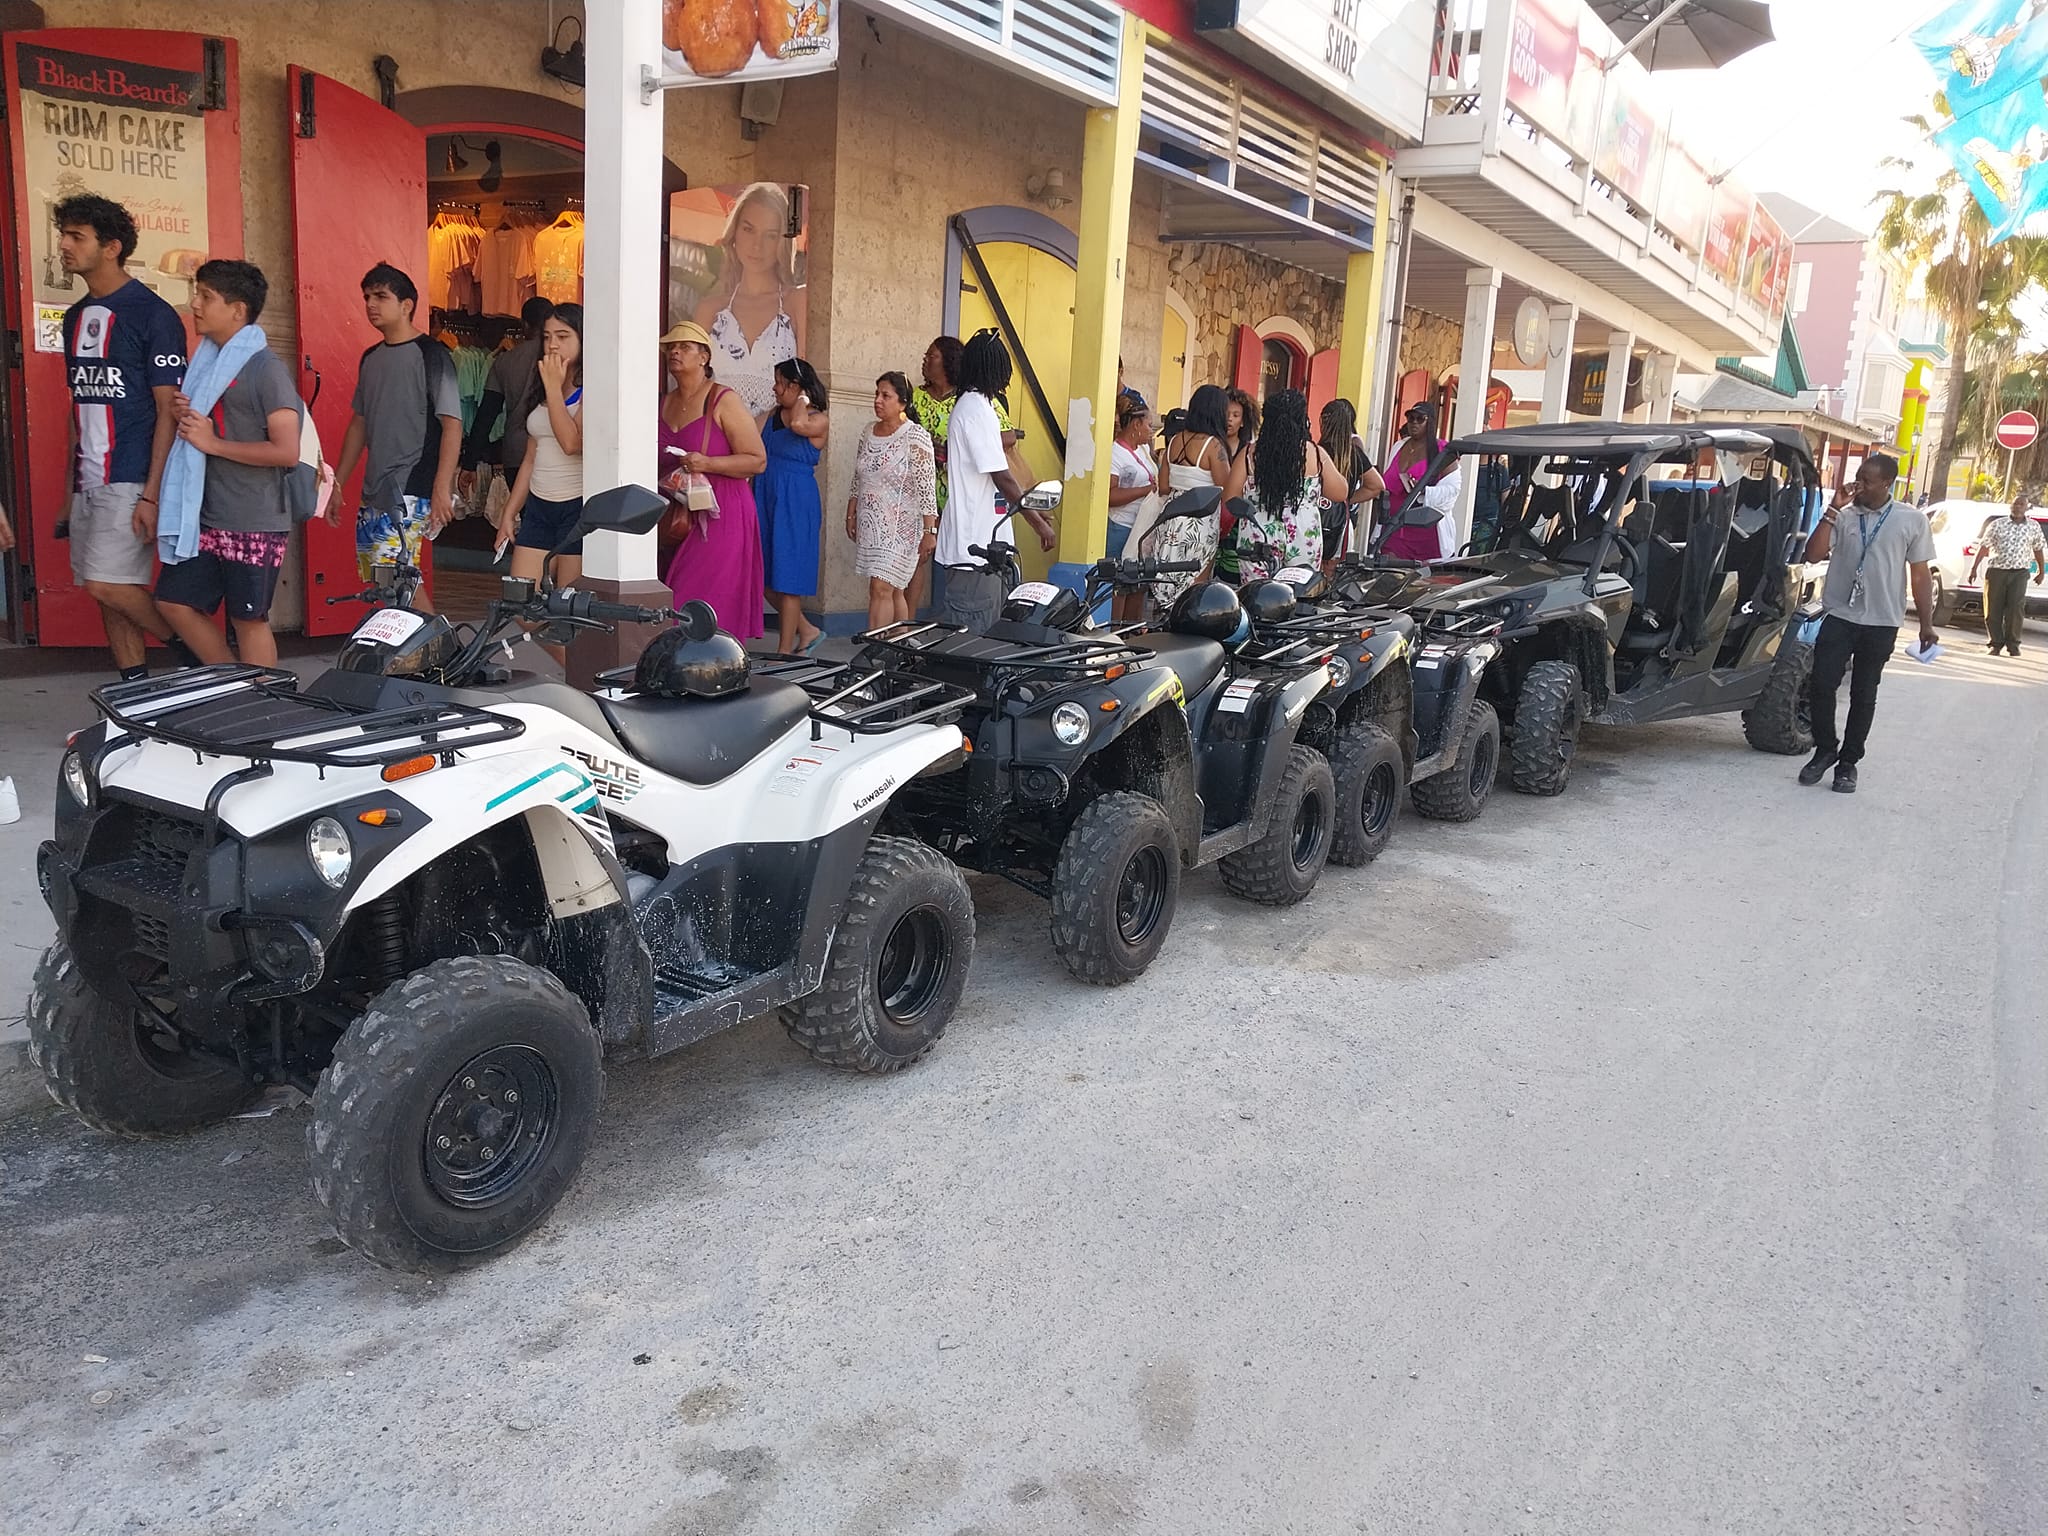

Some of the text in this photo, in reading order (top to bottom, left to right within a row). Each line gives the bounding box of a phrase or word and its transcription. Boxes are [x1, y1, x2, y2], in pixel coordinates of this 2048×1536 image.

[1326, 23, 1357, 77] SHOP
[1512, 43, 1537, 87] GOOD
[36, 57, 189, 106] BlackBeard's
[43, 102, 186, 153] RUM CAKE
[57, 141, 178, 180] SOLD HERE
[131, 213, 190, 234] AILABLE
[852, 775, 896, 811] Kawasaki
